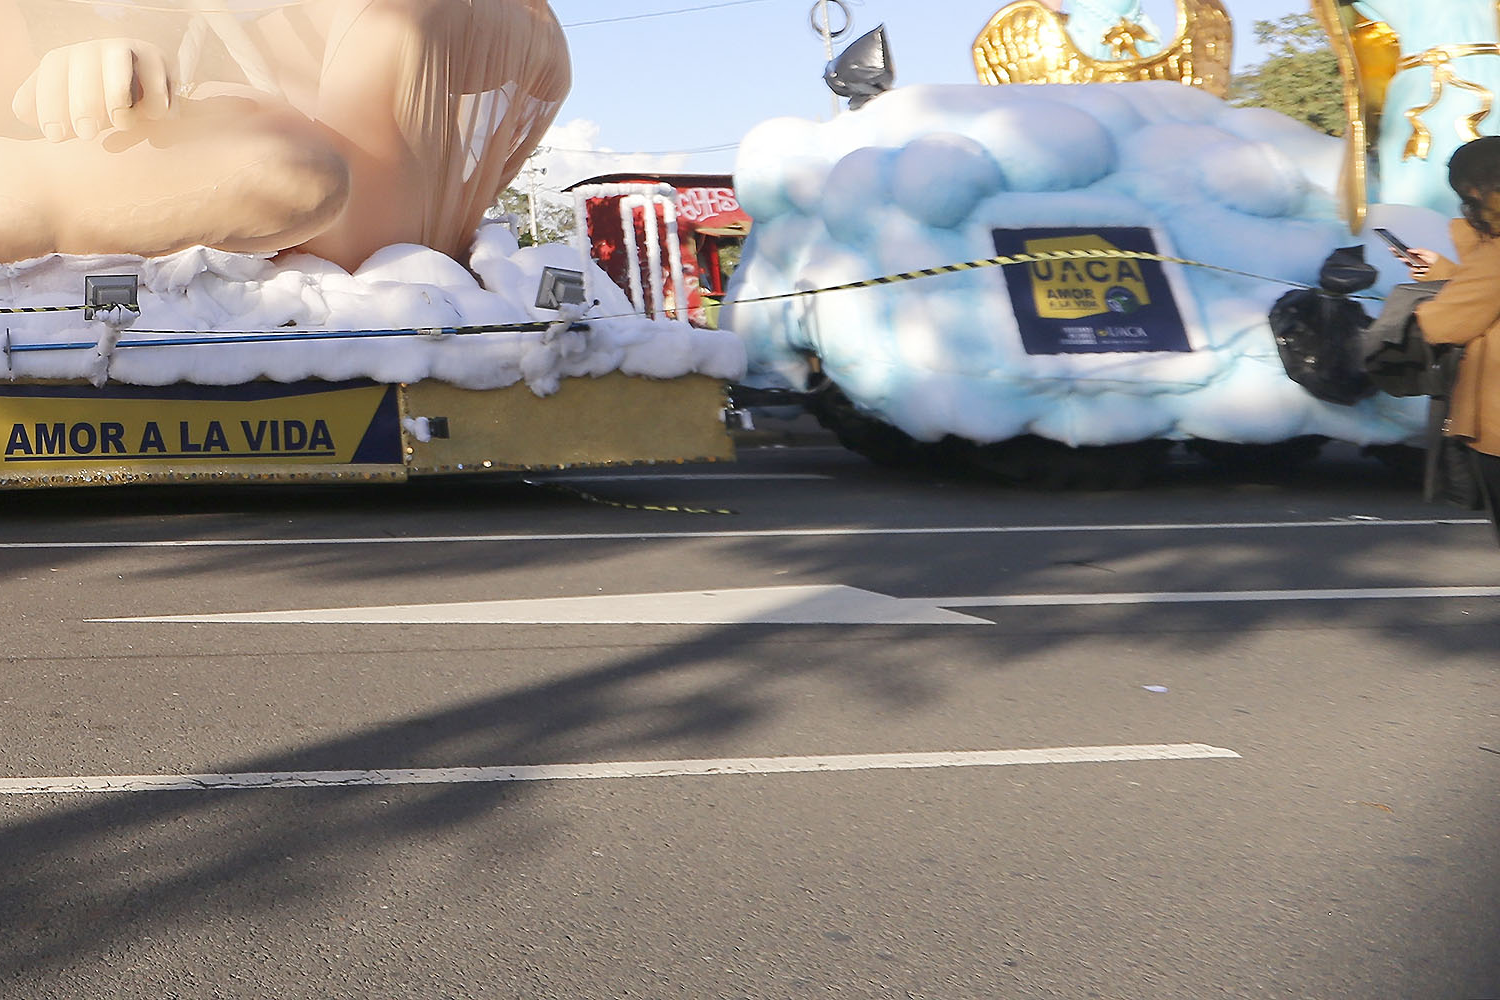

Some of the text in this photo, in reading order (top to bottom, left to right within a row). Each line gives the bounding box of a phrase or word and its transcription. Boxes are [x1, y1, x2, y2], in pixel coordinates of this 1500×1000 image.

[1033, 260, 1142, 283] UACA
[1047, 289, 1096, 299] AMOR
[4, 419, 336, 455] AMOR A LA VIDA
